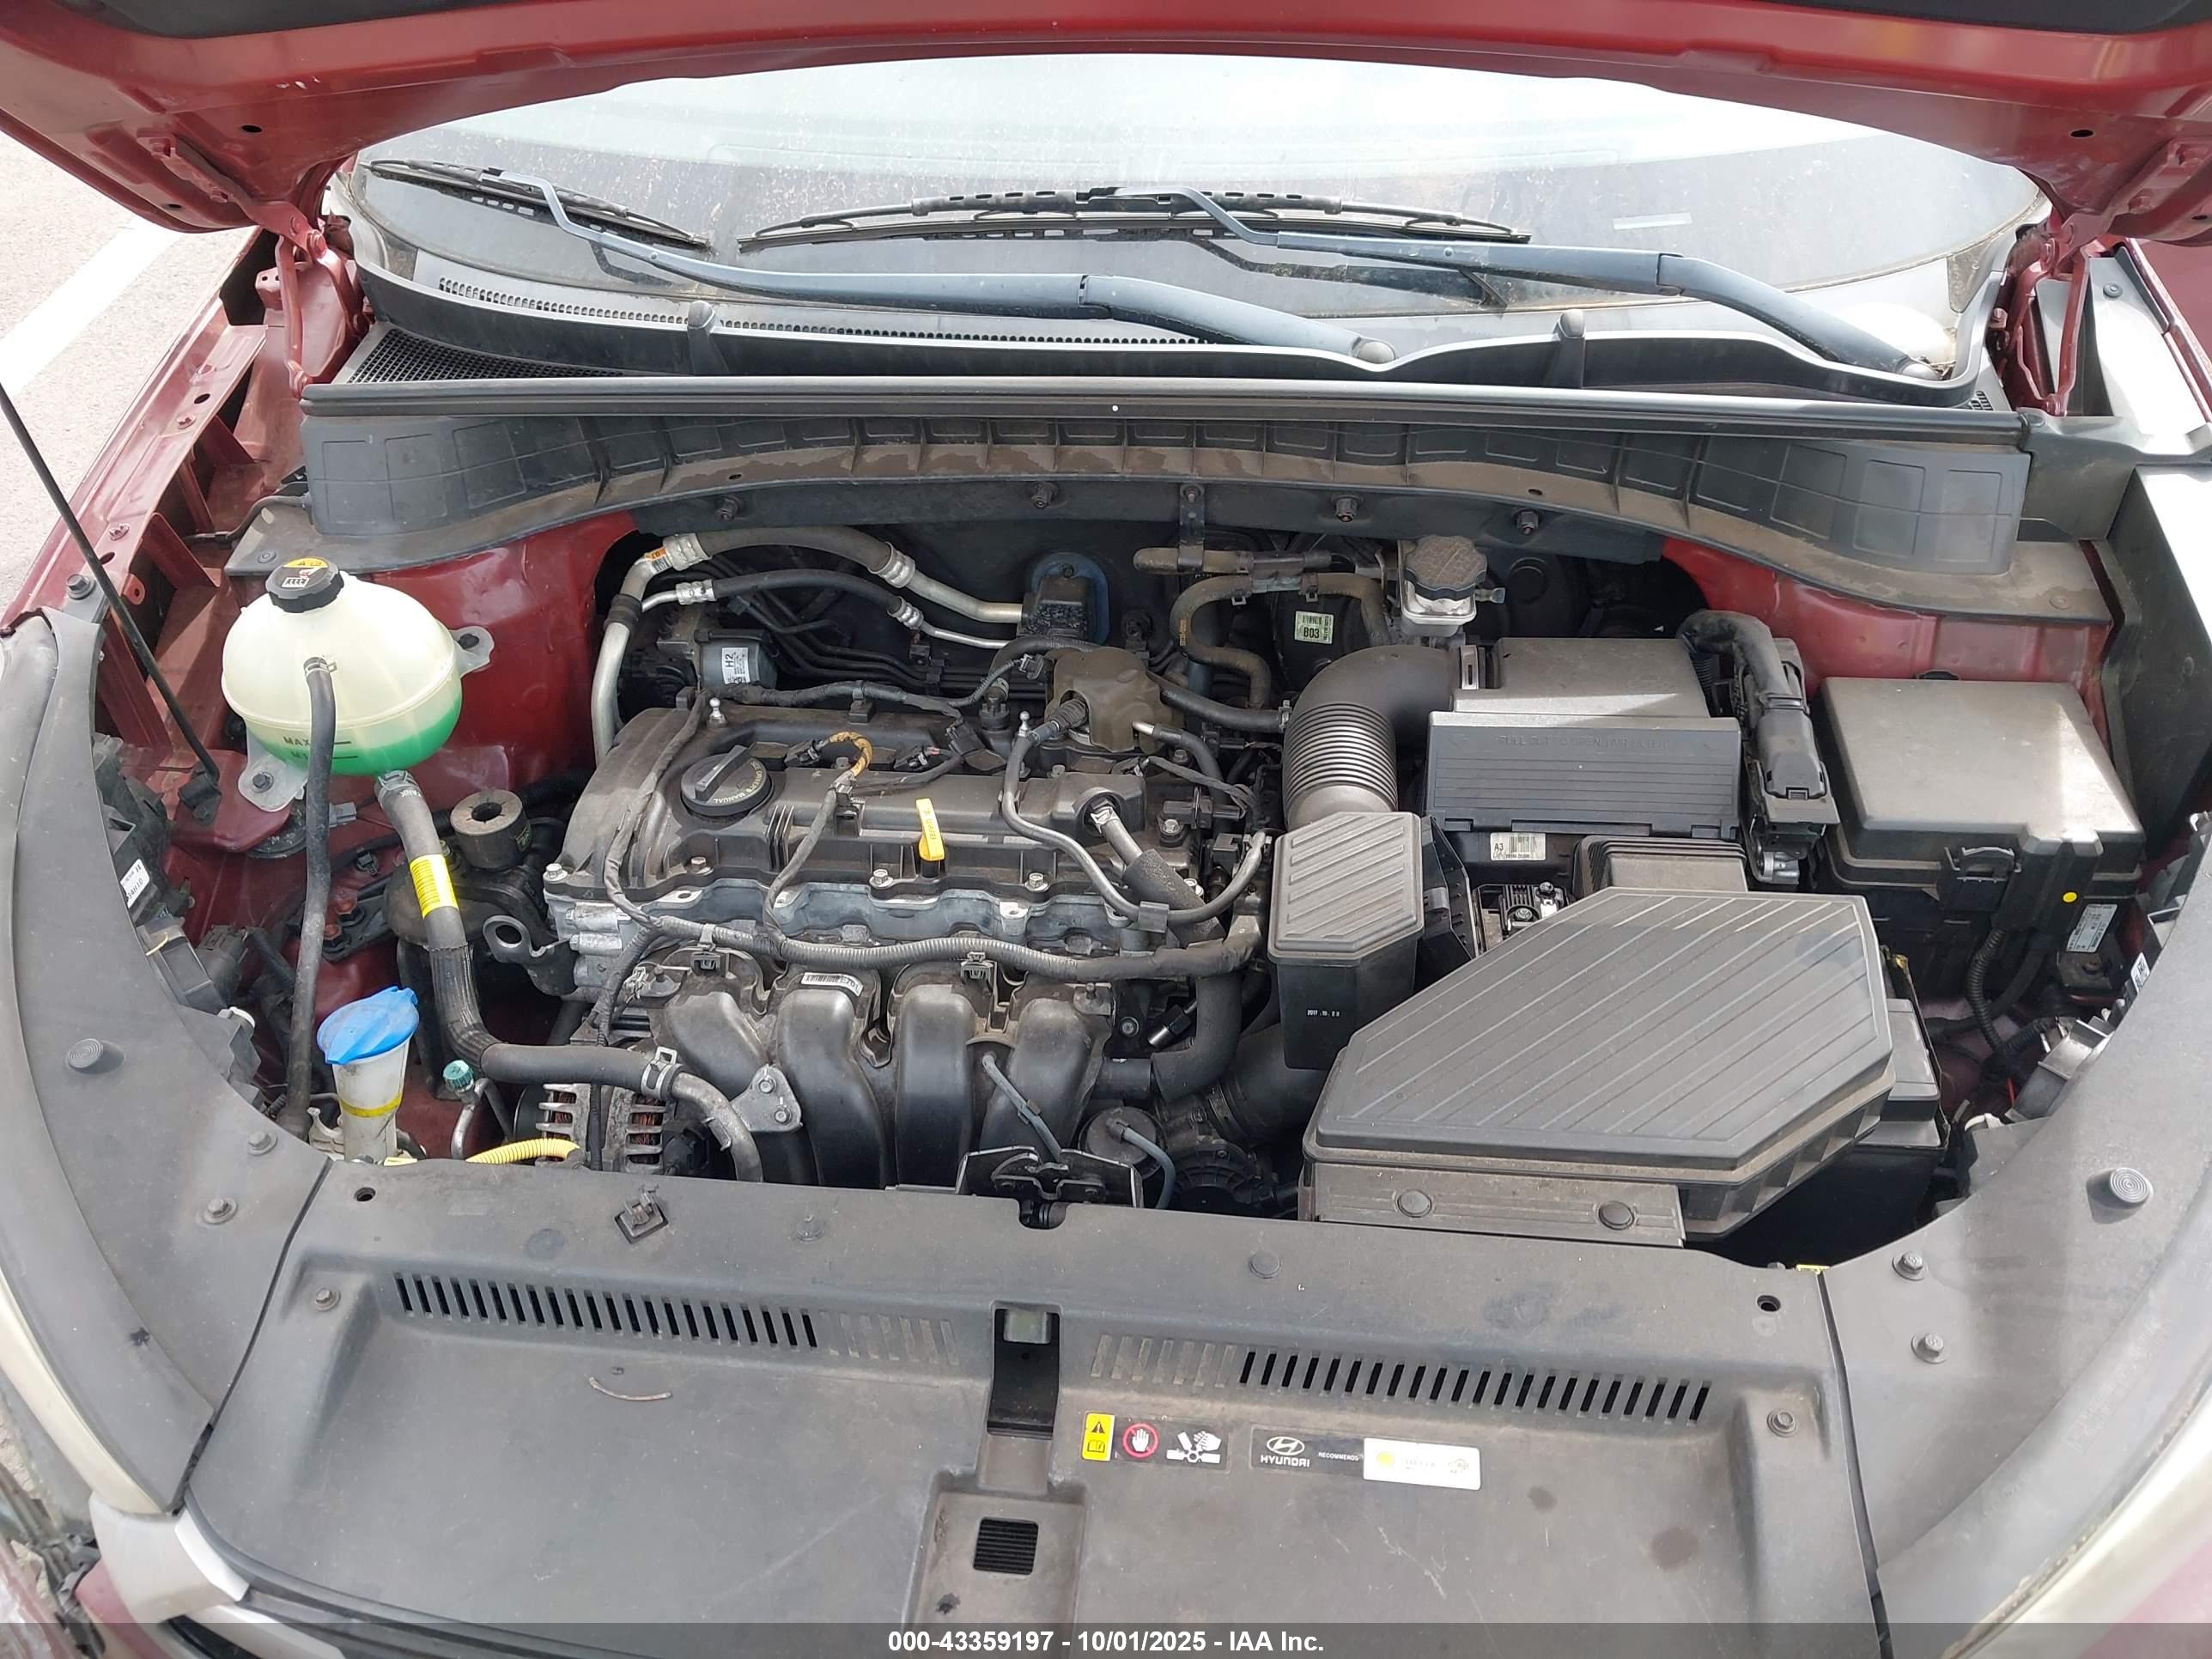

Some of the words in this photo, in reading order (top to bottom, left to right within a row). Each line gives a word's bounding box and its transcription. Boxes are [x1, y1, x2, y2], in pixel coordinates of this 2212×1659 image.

[1304, 626, 1320, 639] B03
[725, 653, 734, 667] H2
[283, 736, 310, 746] MAX
[1494, 842, 1504, 852] A3
[1261, 1454, 1310, 1468] HYUNDAI
[1318, 1451, 1359, 1462] RECOMMENDS
